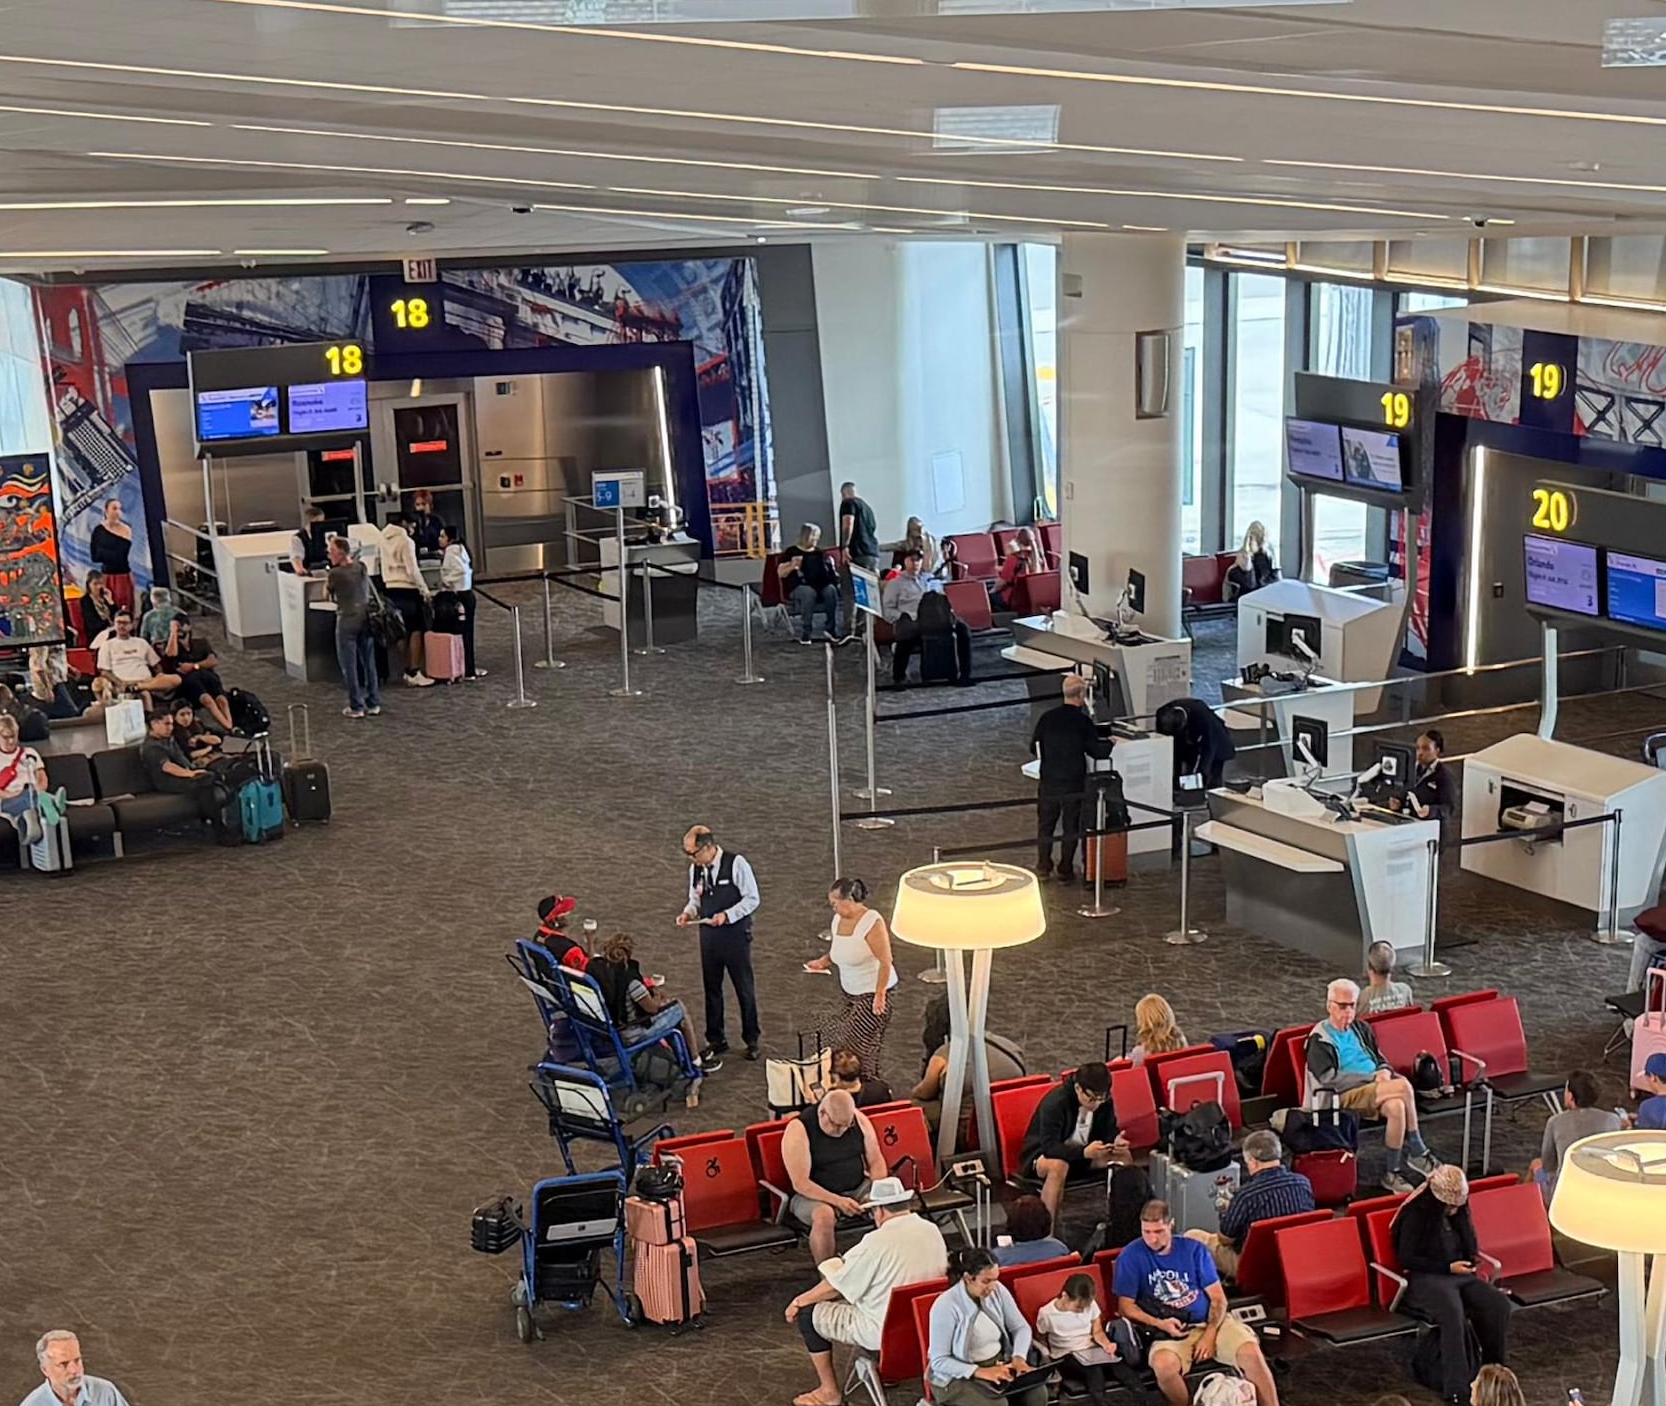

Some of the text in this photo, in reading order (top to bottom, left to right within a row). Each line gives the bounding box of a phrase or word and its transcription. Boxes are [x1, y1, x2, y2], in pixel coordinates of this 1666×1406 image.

[408, 259, 433, 280] EXIT
[391, 298, 429, 328] 18
[325, 345, 363, 375] 18
[1529, 362, 1561, 399] 19
[1380, 392, 1409, 428] 19
[1532, 489, 1569, 531] 20
